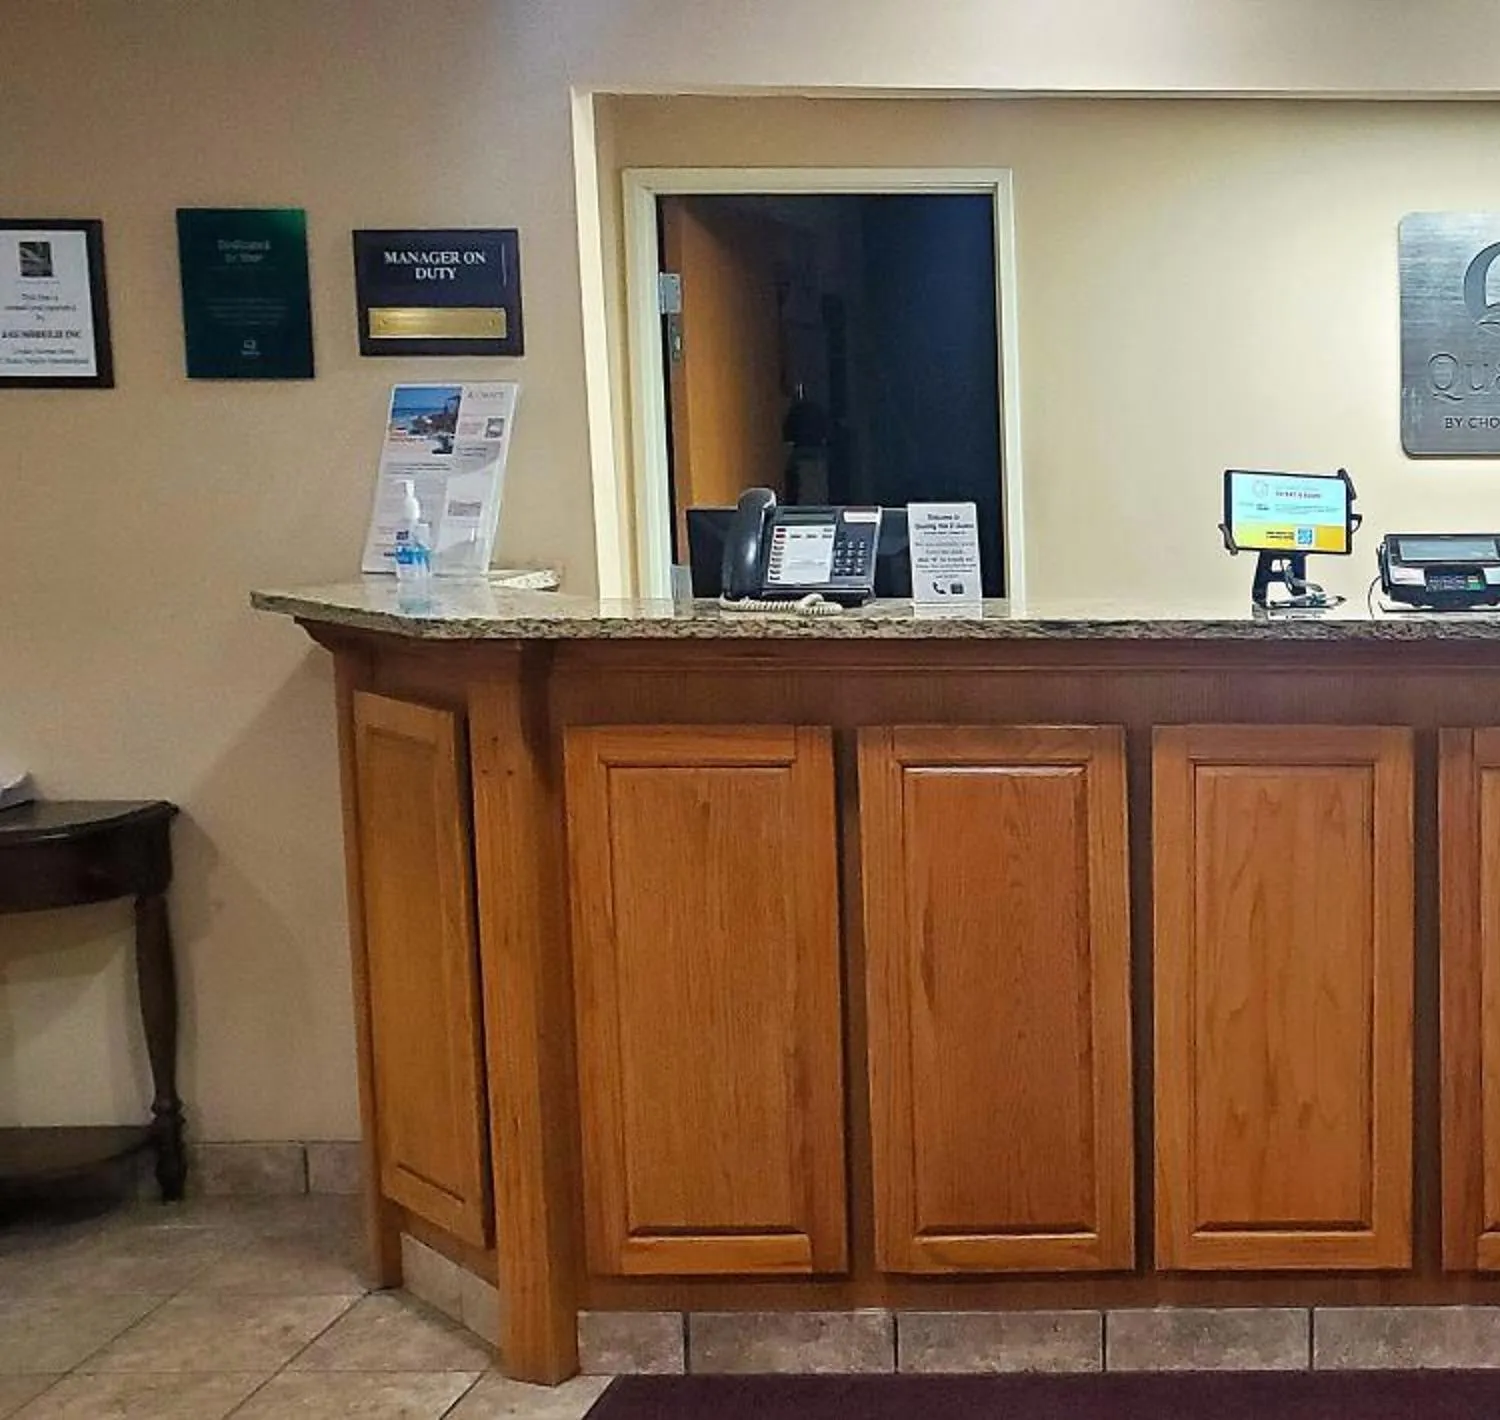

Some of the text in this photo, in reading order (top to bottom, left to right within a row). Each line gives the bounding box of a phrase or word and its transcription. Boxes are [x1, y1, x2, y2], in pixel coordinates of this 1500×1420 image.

[383, 250, 486, 265] MANAGER ON
[415, 267, 458, 280] DUTY
[1444, 416, 1464, 430] BY
